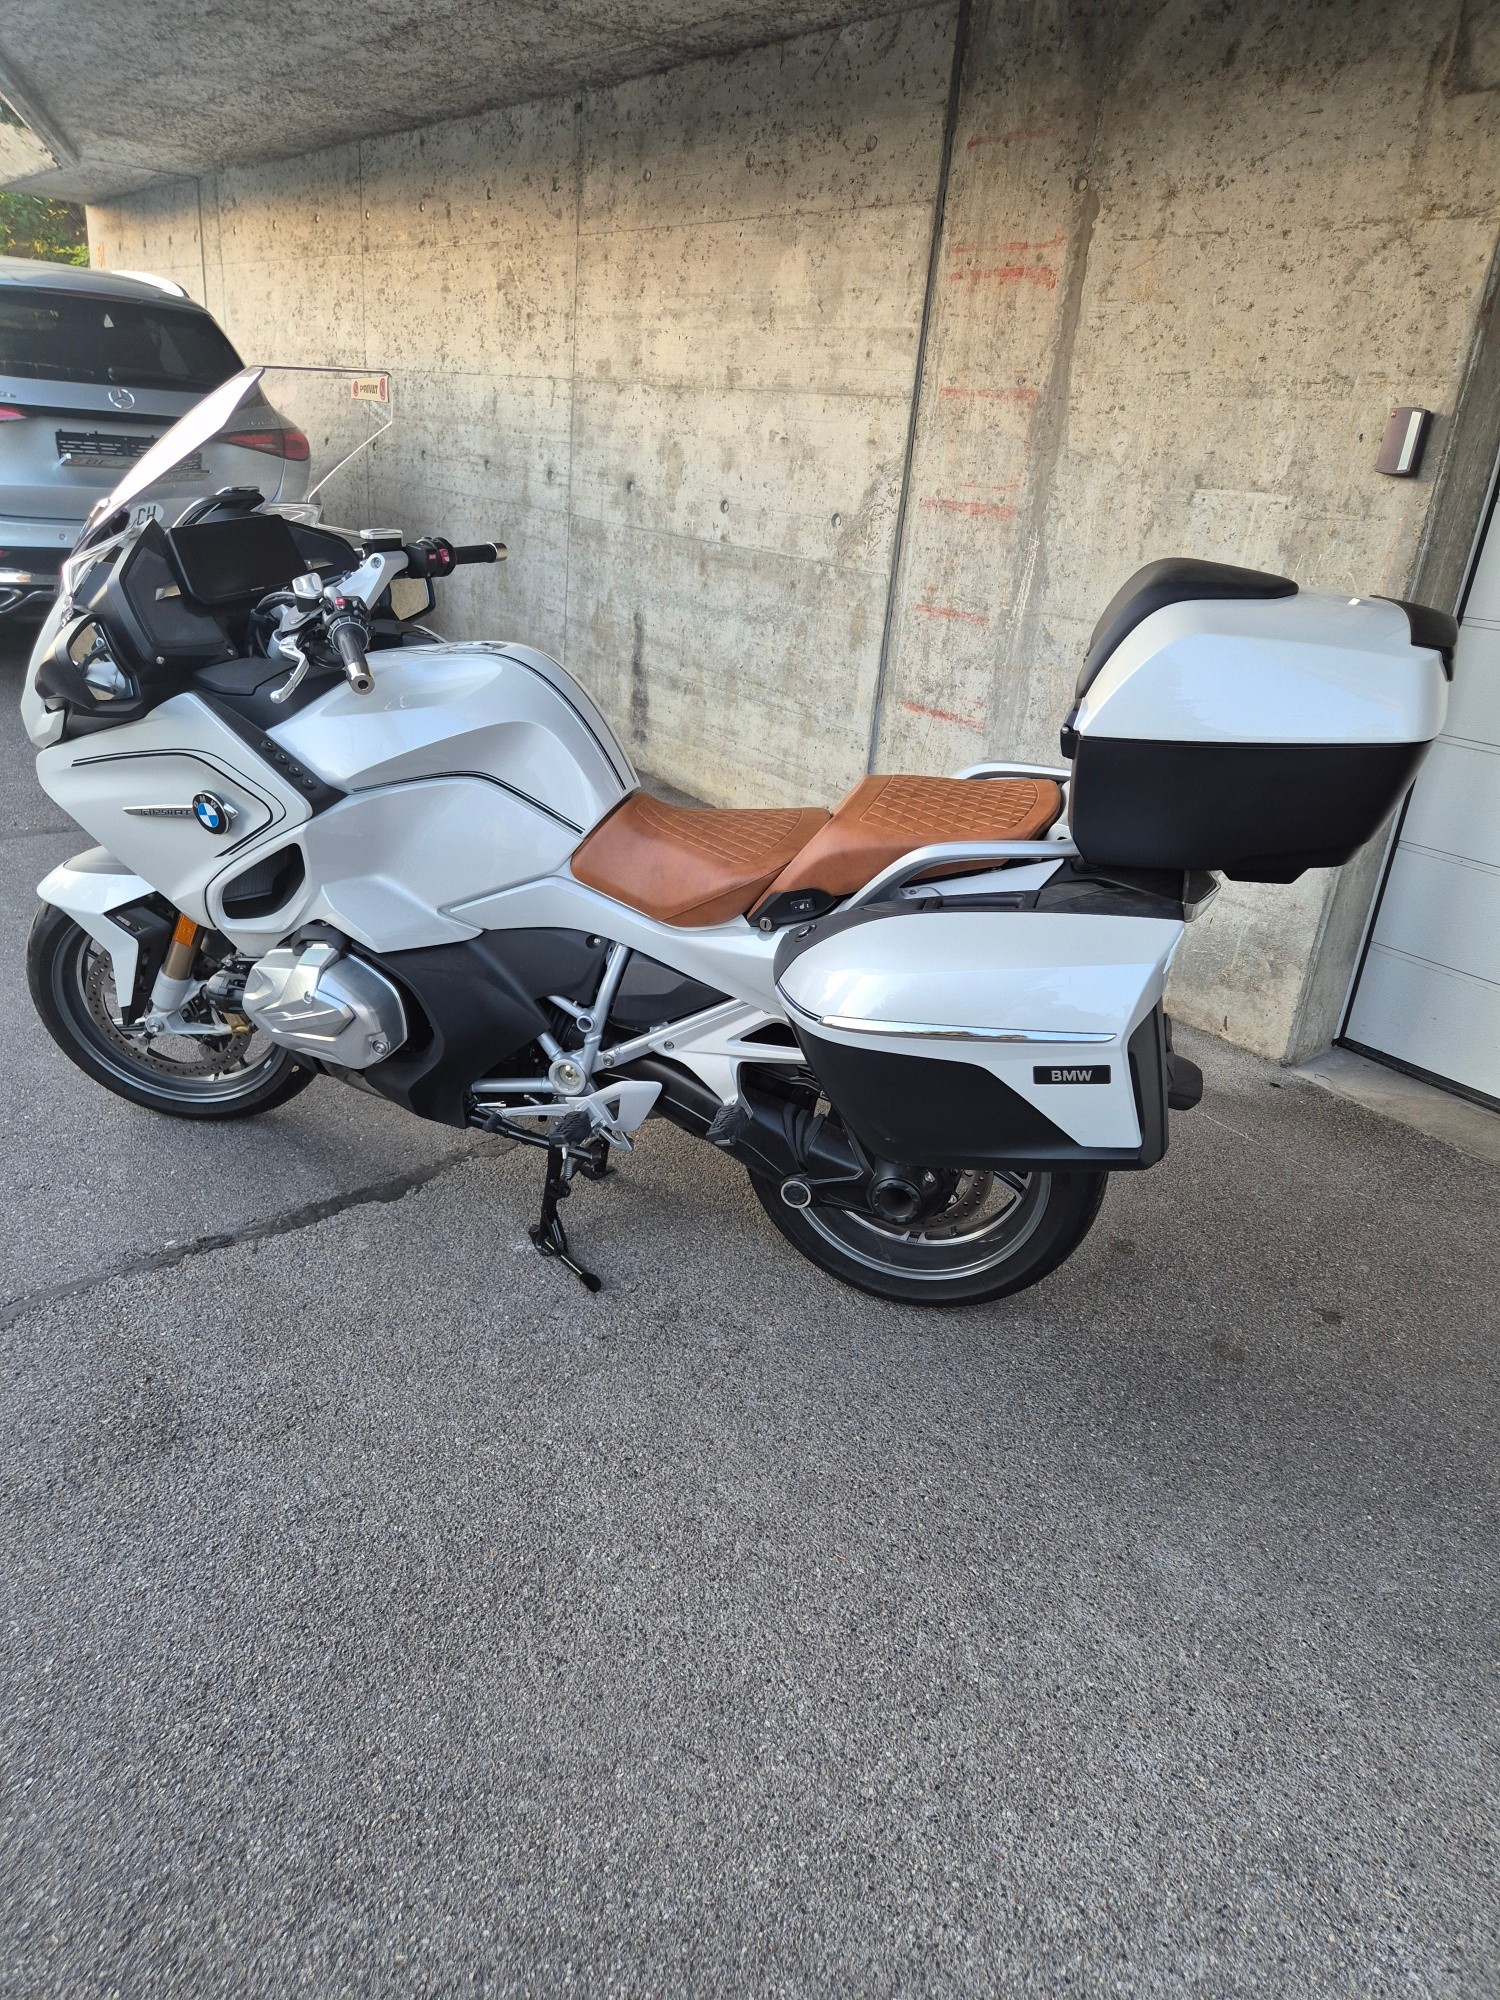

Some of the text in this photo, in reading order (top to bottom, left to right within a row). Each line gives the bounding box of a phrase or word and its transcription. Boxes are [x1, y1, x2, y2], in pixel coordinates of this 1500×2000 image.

[137, 505, 156, 526] CH
[193, 795, 219, 809] BMW
[1051, 1070, 1093, 1082] BMW
